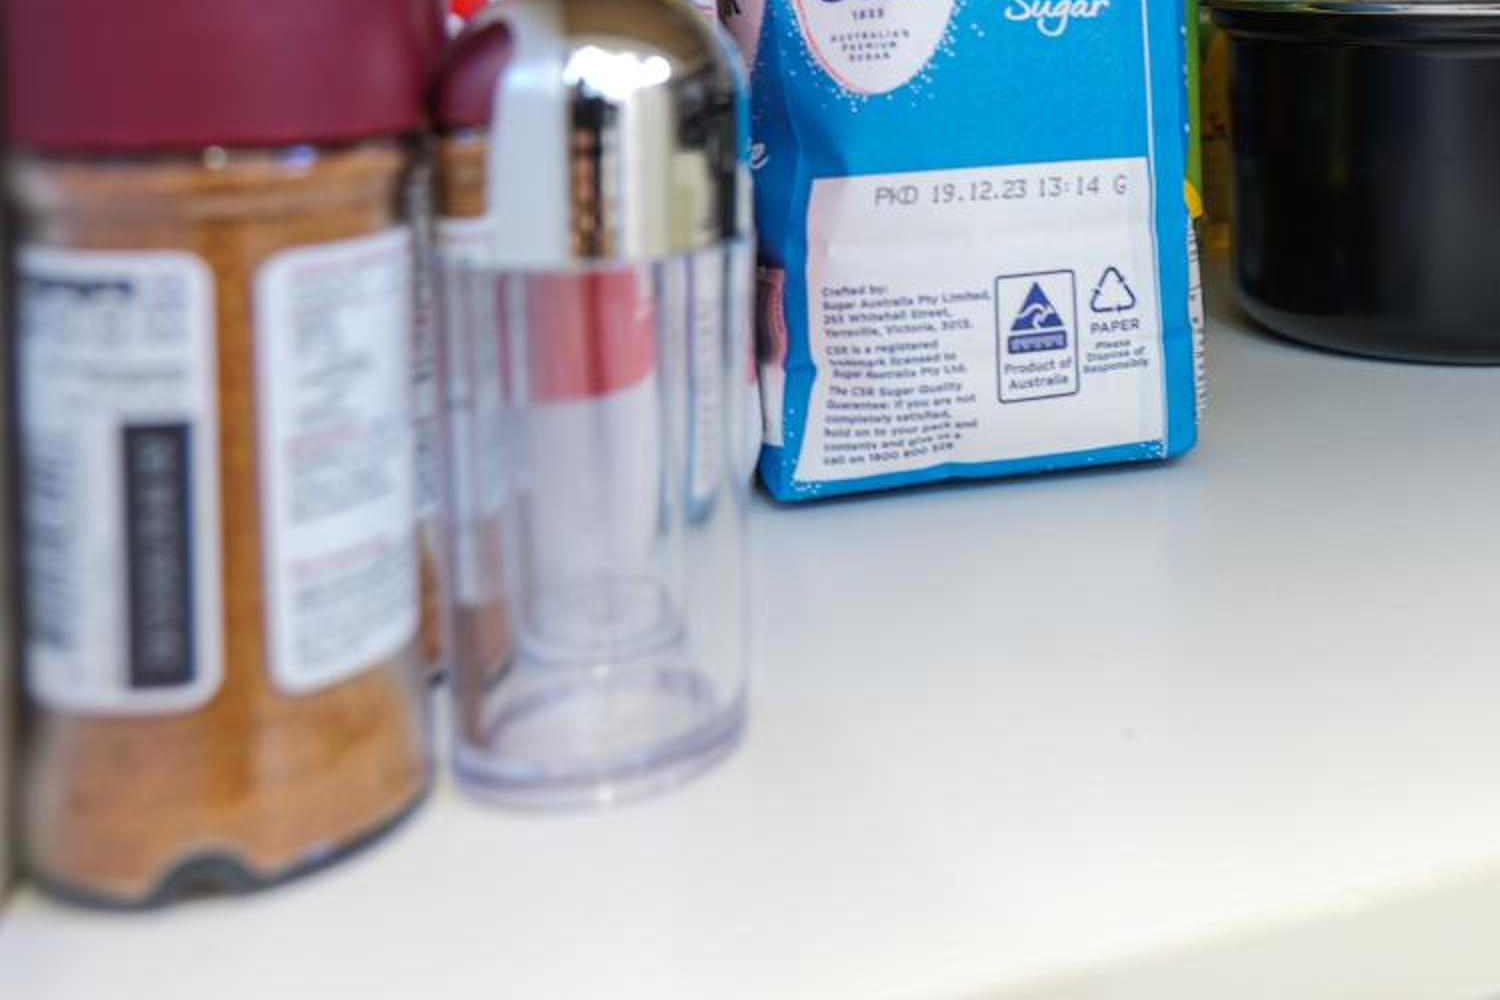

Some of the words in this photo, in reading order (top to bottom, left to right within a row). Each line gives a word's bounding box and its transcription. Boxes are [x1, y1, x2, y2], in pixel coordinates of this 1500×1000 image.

[875, 185, 919, 206] PKD
[932, 179, 1028, 204] 19.12.23
[1039, 175, 1099, 198] 13:14
[821, 285, 865, 297] Crafted
[822, 301, 855, 312] Sugar
[861, 298, 914, 309] Australia
[918, 295, 938, 305] Pty
[1090, 318, 1140, 334] PAPER
[1133, 345, 1146, 355] of
[1004, 359, 1056, 374] Product
[1060, 356, 1072, 368] of
[1009, 374, 1069, 390] Australia
